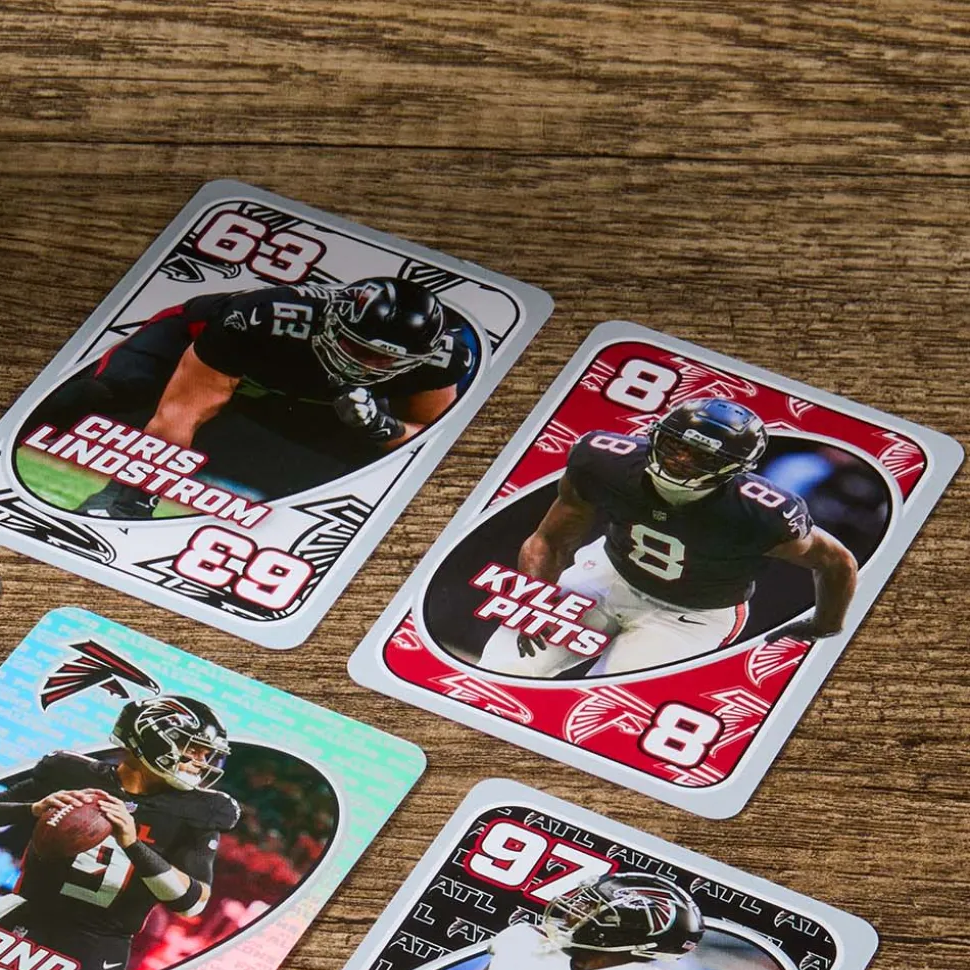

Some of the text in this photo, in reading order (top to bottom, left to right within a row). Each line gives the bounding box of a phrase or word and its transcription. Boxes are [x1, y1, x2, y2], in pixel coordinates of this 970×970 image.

[197, 209, 326, 284] 63
[604, 357, 680, 413] 8
[73, 415, 206, 474] CHRIS
[589, 434, 638, 455] 8
[25, 425, 270, 528] LINDSTROM
[740, 481, 786, 508] 8
[176, 525, 314, 609] 63
[629, 523, 685, 580] 8
[472, 564, 595, 621] KYLE
[477, 598, 608, 657] PITTS
[641, 701, 725, 767] 8
[60, 835, 134, 909] 9
[467, 820, 615, 905] 97
[429, 875, 497, 914] ATL
